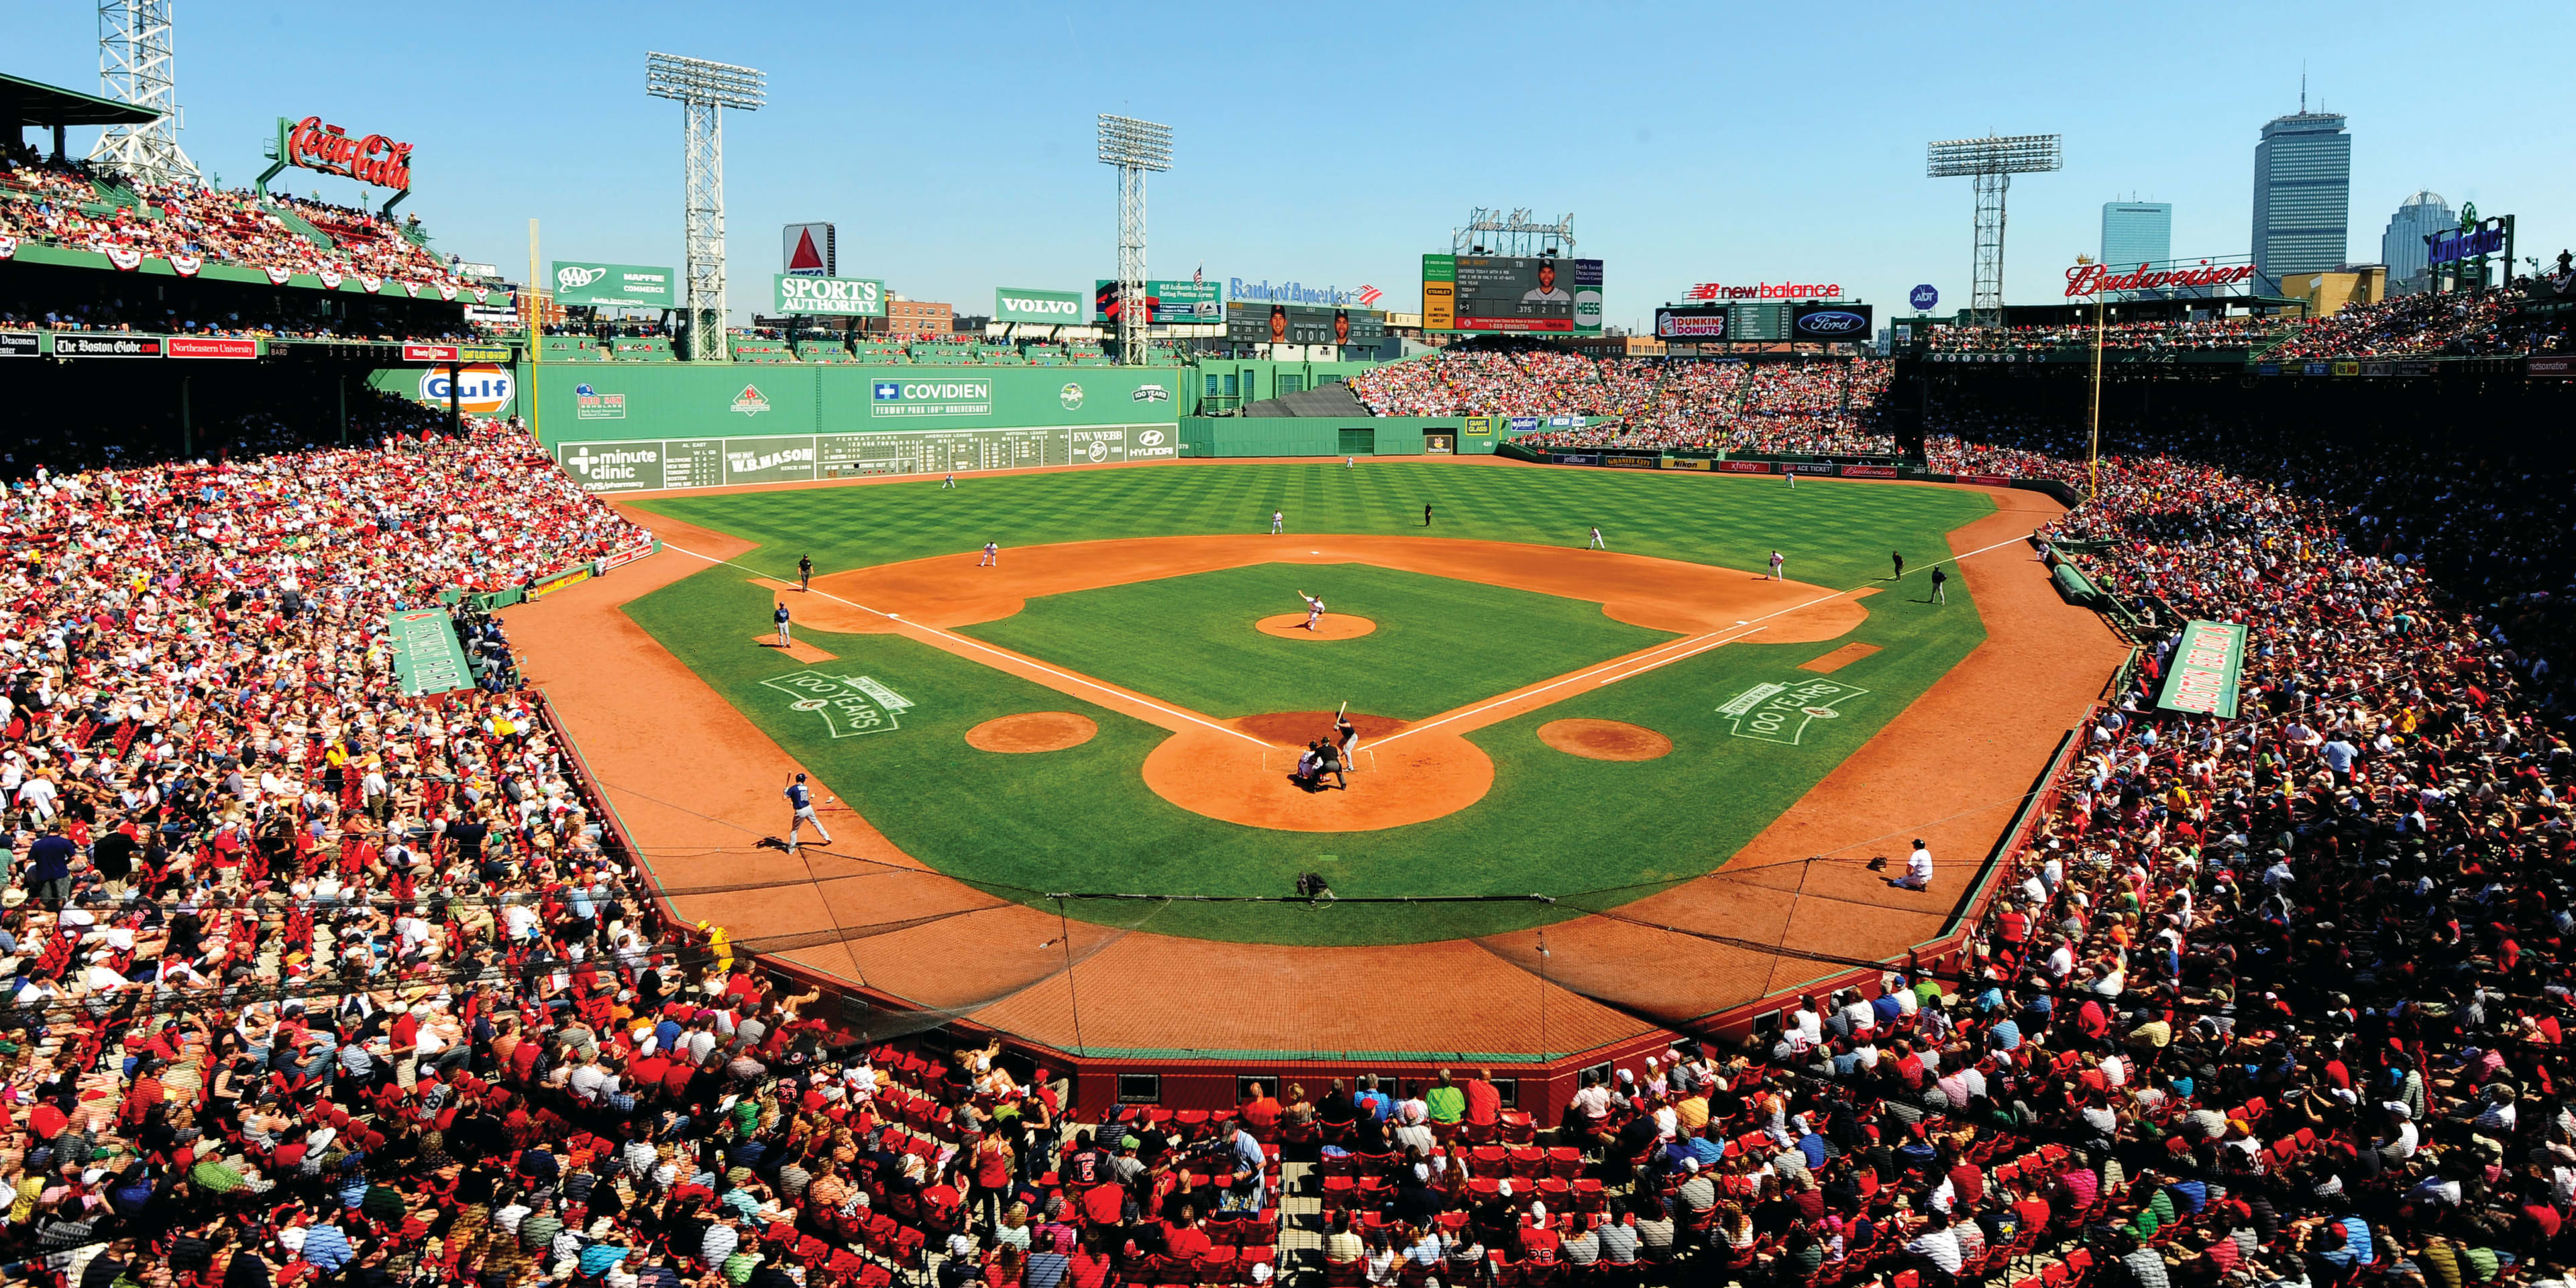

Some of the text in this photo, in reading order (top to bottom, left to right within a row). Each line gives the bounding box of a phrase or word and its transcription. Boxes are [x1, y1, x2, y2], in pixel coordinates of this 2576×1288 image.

[289, 116, 413, 191] Coca-Cola
[1454, 207, 1576, 250] John Hancock
[2429, 225, 2502, 264] Cumberland
[561, 269, 589, 286] AAA
[623, 273, 665, 282] MAPFRE
[2065, 259, 2257, 297] Budweiser
[623, 285, 665, 293] COMMERCE
[782, 278, 877, 301] SPORTS
[1230, 277, 1352, 306] Bank of America
[1721, 281, 1840, 299] new balance
[590, 297, 608, 305] Auto
[1914, 292, 1935, 302] ADT
[1002, 298, 1077, 315] VOLVO
[1577, 302, 1600, 315] HESS
[1677, 316, 1724, 327] DUNKIN'
[1813, 313, 1850, 331] Ford
[1296, 330, 1326, 341] 0 0 0
[1677, 326, 1720, 335] DONUTS
[1, 335, 36, 345] Deaconess
[57, 339, 159, 354] The Boston Globe.com
[0, 347, 15, 355] enter
[172, 342, 253, 356] Northeastern University
[270, 348, 288, 356] BARD
[412, 348, 449, 358] Ninety Nine
[2528, 361, 2568, 371] redsoxnation
[428, 378, 506, 397] Gulf
[904, 384, 987, 399] COVIDIEN
[1146, 390, 1167, 398] YEARS
[581, 396, 623, 405] RED SOX
[876, 405, 988, 415] FENWAY PARK ANNIVERSARY
[1093, 431, 1123, 441] WEBB
[600, 449, 657, 464] minute
[1130, 447, 1173, 457] HYUNDAI
[1607, 457, 1635, 466] GRANITE
[1636, 459, 1652, 467] CITY
[1673, 460, 1698, 469] Nikon
[1731, 462, 1758, 472] xfinity
[591, 464, 636, 480] clinic
[1844, 466, 1896, 476] Budweiser
[582, 480, 645, 491] CVS/pharmacy
[405, 621, 451, 661] FENWAY
[413, 658, 462, 690] PARK
[2172, 631, 2233, 714] BOSTON RED SOX
[787, 676, 881, 729] 100 YEARS
[1748, 684, 1841, 735] 100 YEARS
[1793, 1037, 1808, 1052] 15
[424, 1089, 442, 1110] 28
